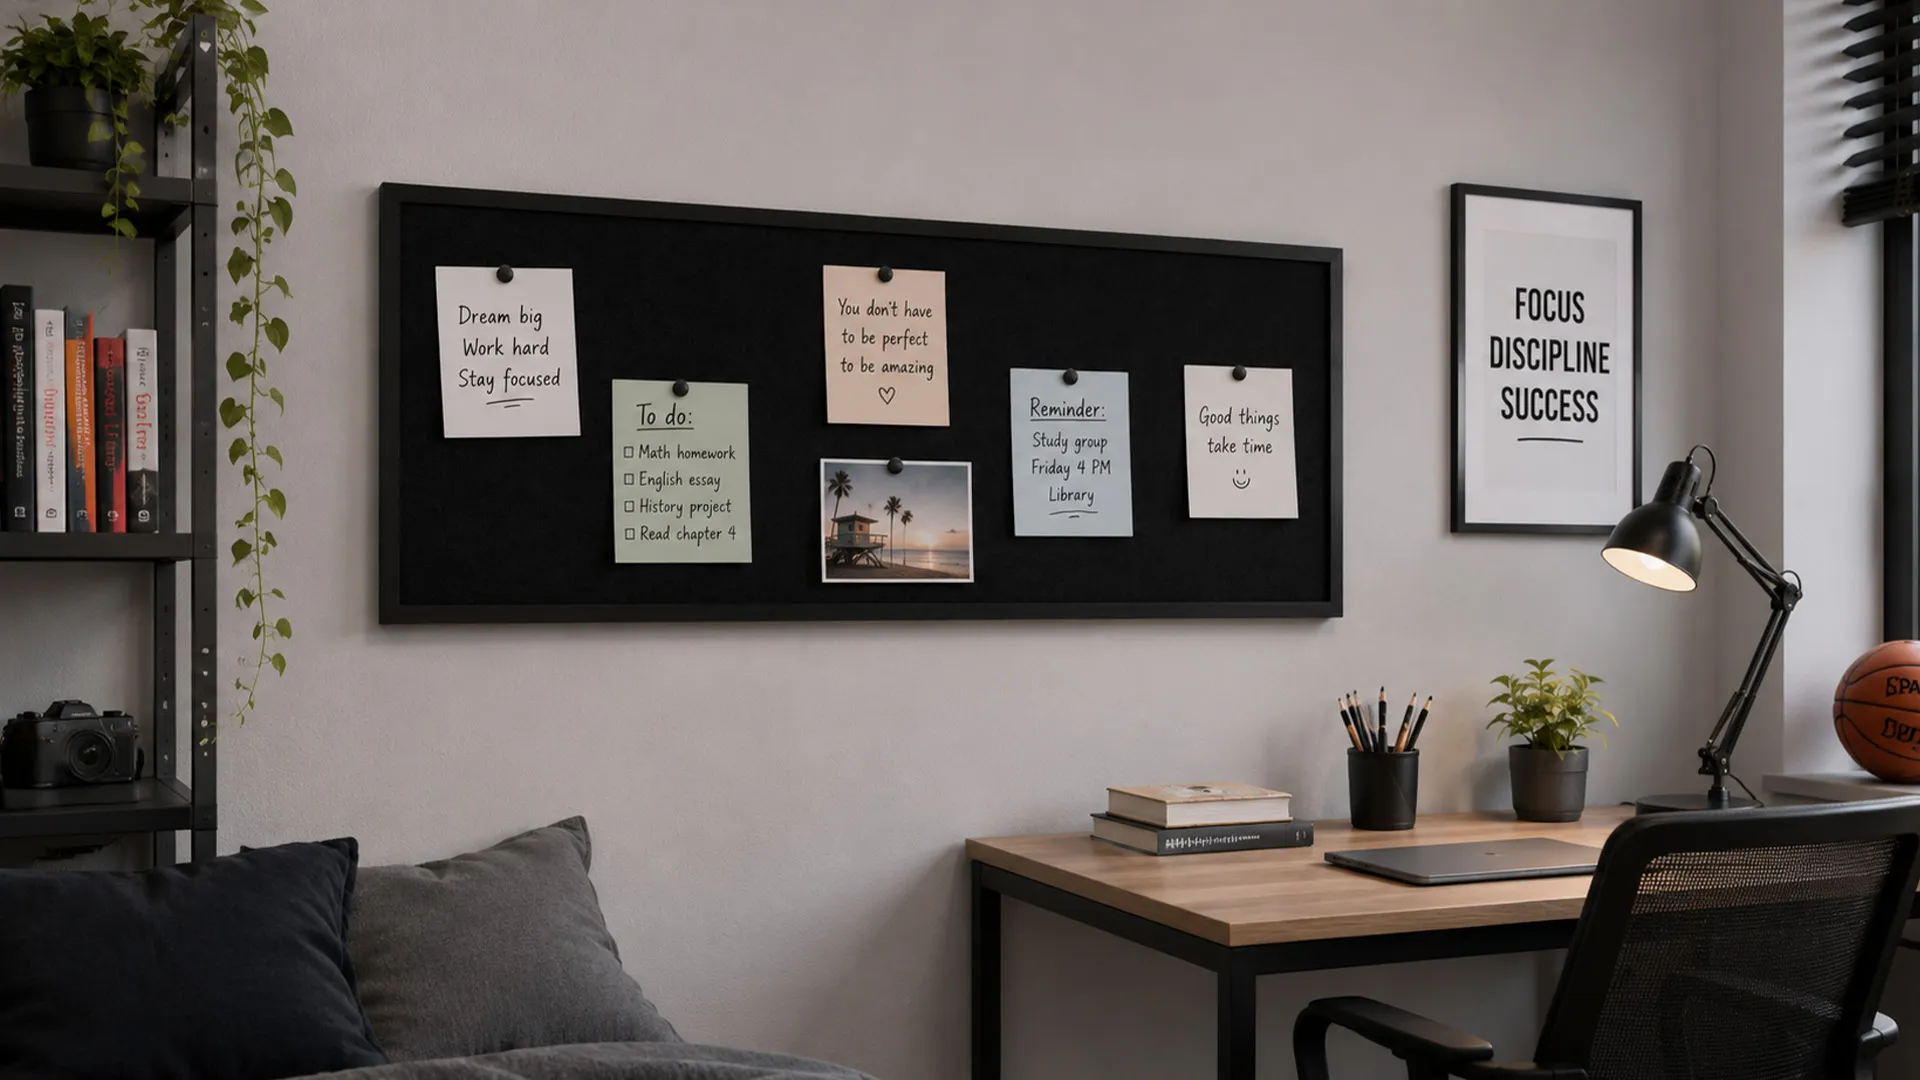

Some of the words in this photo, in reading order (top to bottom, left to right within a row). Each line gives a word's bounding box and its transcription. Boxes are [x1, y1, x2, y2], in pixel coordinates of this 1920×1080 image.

[837, 297, 860, 316] You
[866, 298, 898, 318] don't
[904, 300, 933, 319] have
[1515, 287, 1585, 324] FOCUS
[458, 304, 511, 325] Dream
[519, 304, 542, 332] big
[463, 336, 505, 357] Work
[512, 335, 549, 356] hard
[841, 328, 855, 344] to
[861, 326, 876, 345] be
[882, 328, 929, 352] perfect
[1490, 335, 1610, 375] DISCIPLINE
[840, 356, 854, 373] to
[860, 355, 875, 373] be
[881, 360, 934, 382] amazing
[458, 368, 495, 395] Stay
[503, 367, 561, 393] focused
[636, 402, 657, 426] To
[665, 402, 692, 426] do:
[1030, 396, 1105, 418] Reminder:
[1500, 386, 1599, 424] SUCCESS
[1198, 405, 1233, 427] Good
[1238, 407, 1280, 433] things
[638, 443, 671, 460] Math
[677, 443, 736, 460] homework
[1032, 431, 1069, 455] Study
[1074, 437, 1108, 455] group
[1207, 435, 1237, 454] take
[1242, 437, 1273, 454] time
[639, 470, 683, 493] English
[688, 476, 721, 493] essay
[1031, 458, 1071, 482] Friday
[1076, 459, 1086, 475] 4
[1091, 458, 1111, 475] PM
[639, 497, 684, 520] History
[689, 498, 732, 520] project
[1049, 486, 1095, 508] Library
[640, 524, 671, 541] Read
[676, 524, 722, 548] chapter
[727, 525, 737, 541] 4
